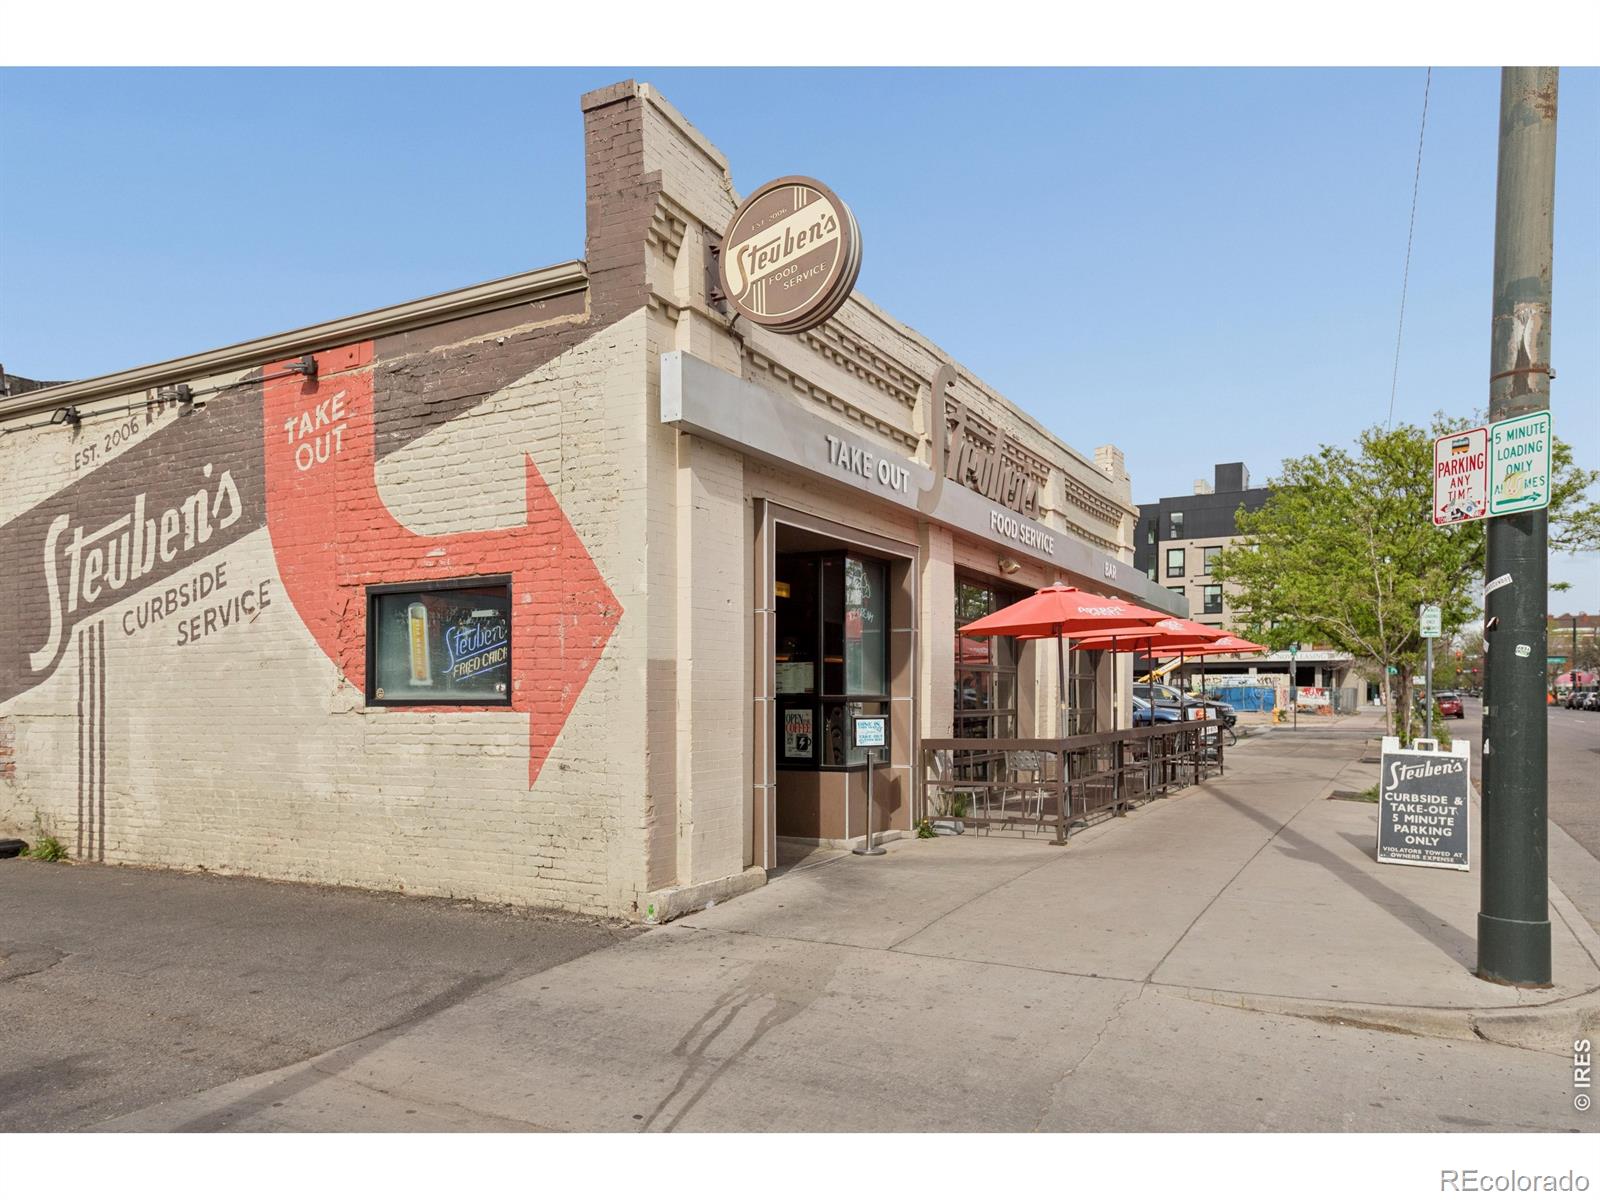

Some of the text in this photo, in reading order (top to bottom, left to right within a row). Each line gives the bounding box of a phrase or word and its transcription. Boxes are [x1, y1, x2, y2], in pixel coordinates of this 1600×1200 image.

[735, 213, 837, 300] Steuben's
[768, 264, 798, 286] FOOD
[783, 262, 828, 290] SERVICE
[284, 390, 347, 444] TAKE
[74, 416, 140, 470] EST. 2006
[1495, 421, 1546, 445] 5 MINUTE
[295, 423, 348, 472] OUT
[1497, 440, 1543, 461] LOADING
[825, 434, 911, 493] TAKE OUT
[1438, 453, 1484, 479] PARKING
[1506, 460, 1533, 475] ONLY
[1450, 474, 1471, 489] ANY
[990, 510, 1054, 555] FOOD SERVICE
[29, 463, 243, 672] Steuben's
[122, 561, 228, 636] CURBSIDE
[177, 579, 272, 647] SERVICE
[453, 656, 480, 678] FRIED
[1386, 759, 1463, 790] Steuben's
[1385, 792, 1463, 805] CURBSIDE &
[1390, 803, 1457, 815] TAKE-OUT
[1392, 814, 1454, 826] 5 MINUTE
[1394, 824, 1452, 837] PARKING
[1383, 846, 1422, 855] VIOLATORS
[1405, 835, 1439, 846] ONLY
[1391, 852, 1454, 863] OWNERS EXPENSE
